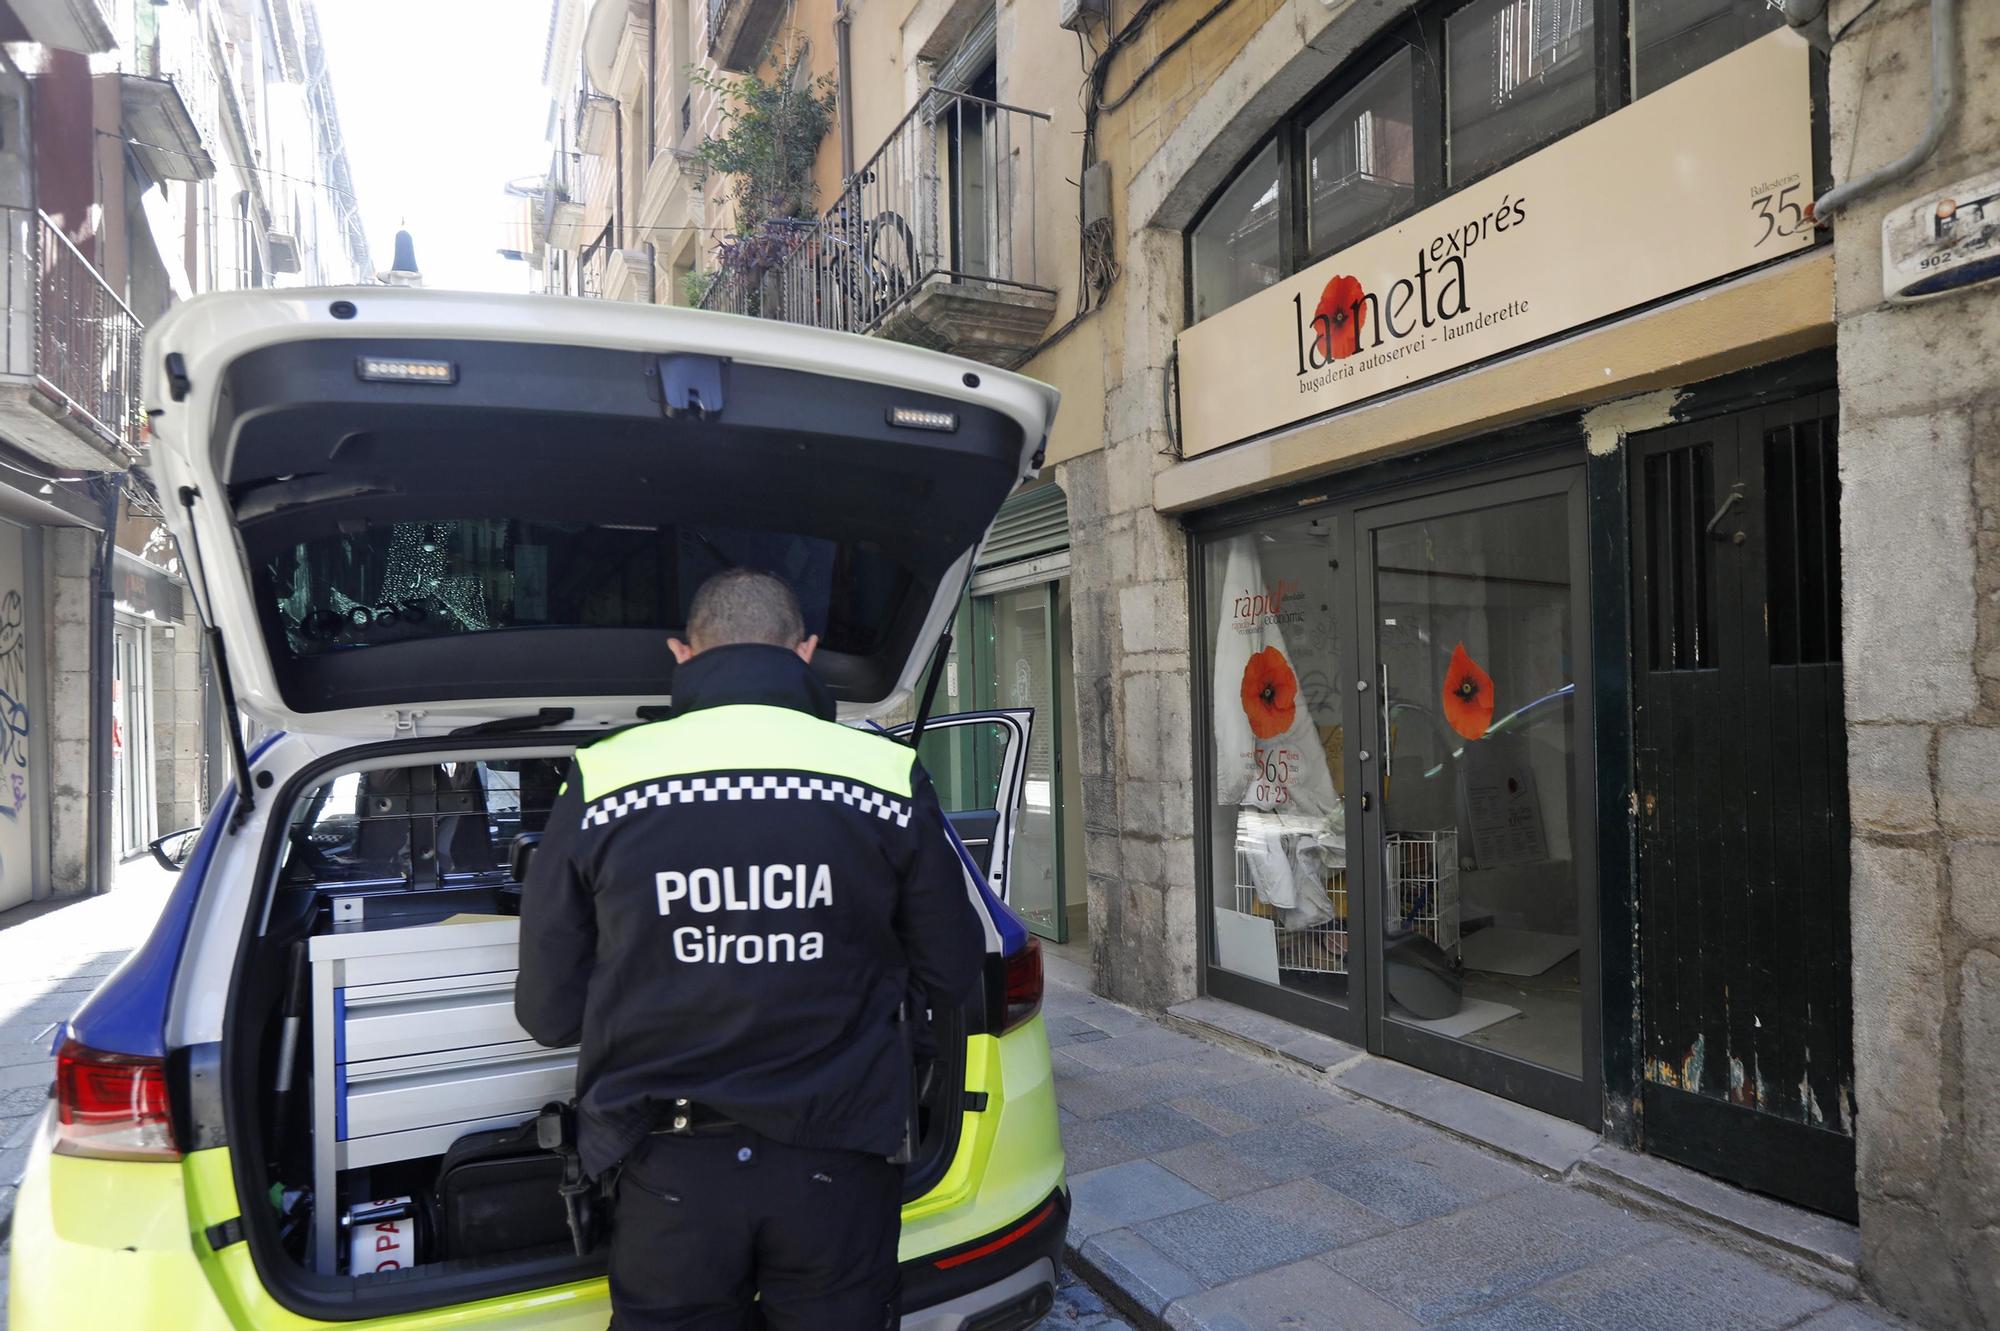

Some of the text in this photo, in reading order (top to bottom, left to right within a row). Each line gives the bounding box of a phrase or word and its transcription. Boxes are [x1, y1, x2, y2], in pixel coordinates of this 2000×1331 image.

[1429, 194, 1527, 259] exprés
[1751, 182, 1802, 247] 35
[1920, 252, 1952, 269] 902
[1299, 362, 1354, 394] bugaderia
[1358, 338, 1426, 372] autoservei
[1442, 297, 1529, 342] launderette
[1253, 748, 1289, 783] 365
[655, 863, 833, 916] POLICIA
[672, 925, 824, 964] Girona
